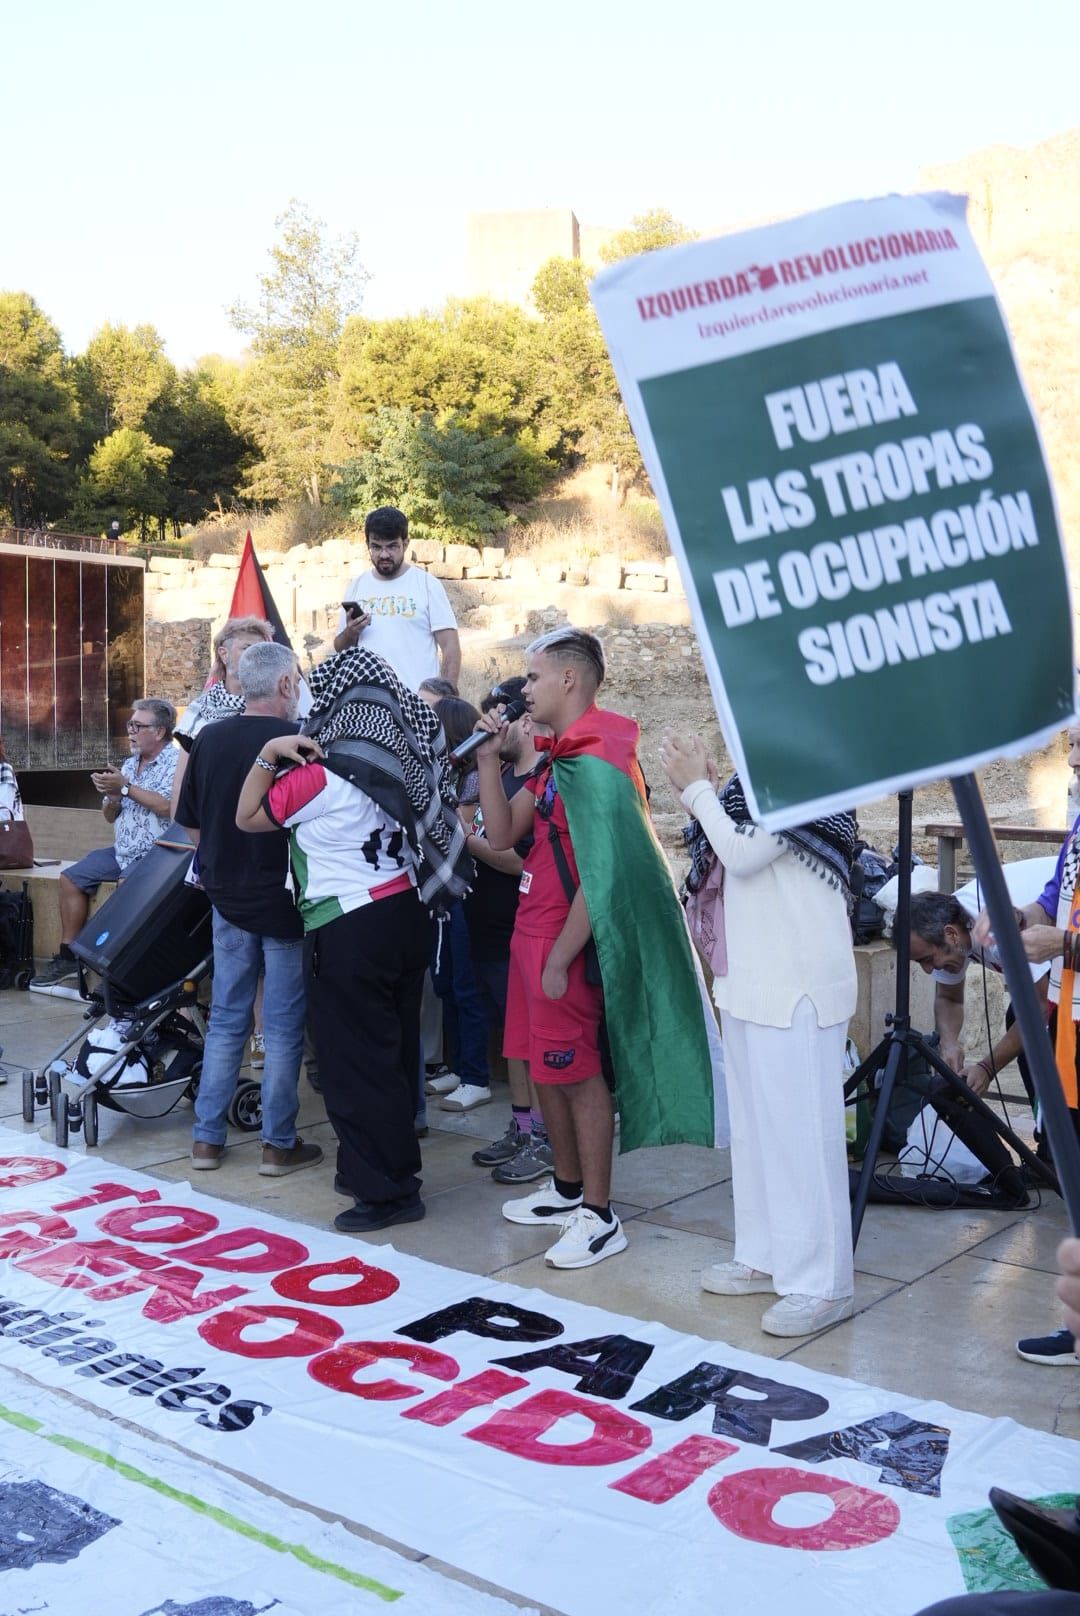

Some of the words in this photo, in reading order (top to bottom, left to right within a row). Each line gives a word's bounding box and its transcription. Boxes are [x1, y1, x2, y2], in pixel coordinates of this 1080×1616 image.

[636, 272, 751, 321] IZQUIERDA
[778, 228, 959, 285] REVOLUCIONARIA
[697, 269, 930, 339] izquierdarevolucionaria.net
[765, 362, 918, 450] FUERA
[721, 470, 816, 544] LAS
[812, 423, 994, 517] TROPAS
[712, 559, 782, 628] DE
[778, 489, 1039, 609] OCUPACIÓN
[798, 580, 1012, 686] SIONISTA
[0, 1211, 900, 1551] GENOCIDIO
[51, 1182, 401, 1307] TODO
[393, 1296, 951, 1498] PARA
